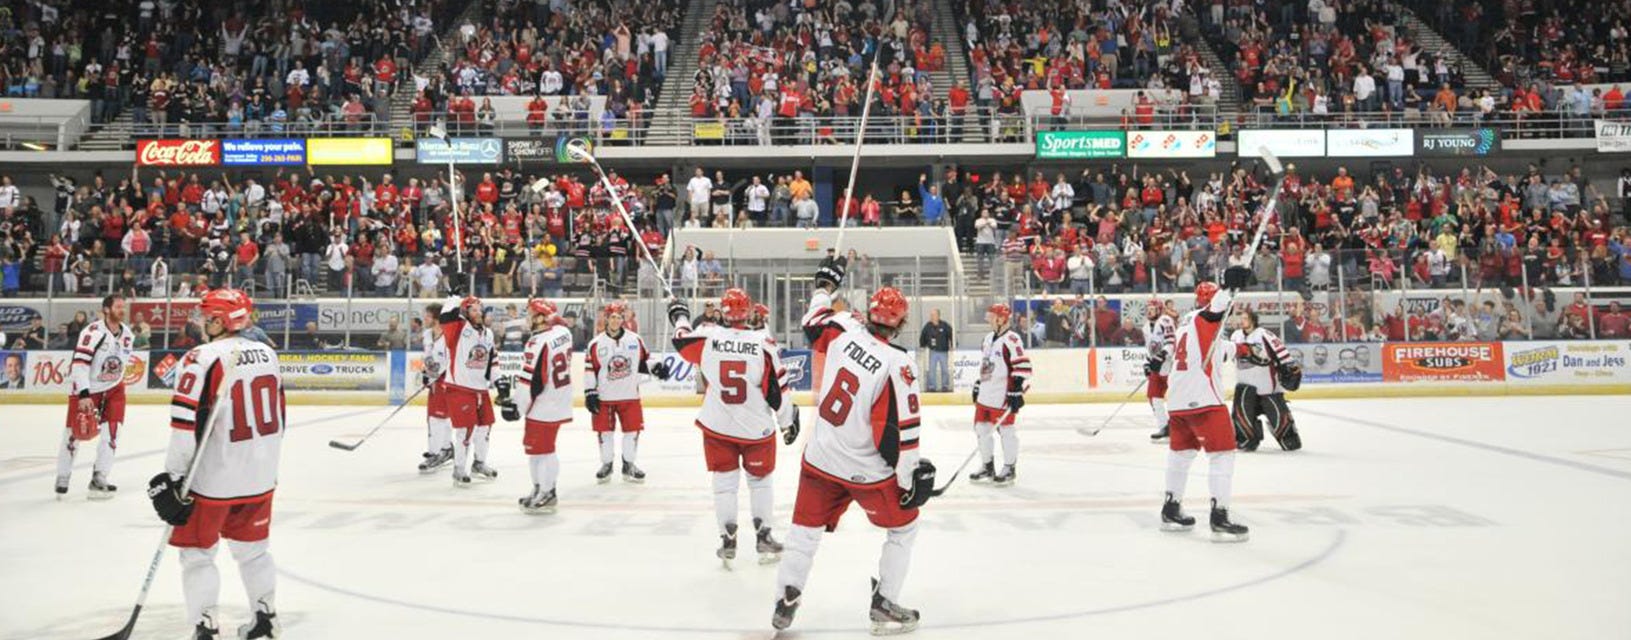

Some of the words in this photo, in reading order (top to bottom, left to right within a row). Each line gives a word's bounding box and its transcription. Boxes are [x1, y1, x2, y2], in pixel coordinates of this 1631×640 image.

[223, 142, 237, 151] We
[264, 144, 282, 153] your
[1423, 139, 1434, 149] RJ
[1438, 139, 1475, 147] YOUNG
[141, 140, 216, 165] Coca-Cola
[712, 339, 758, 356] McCLURE
[1395, 347, 1491, 363] FIREHOUSE
[842, 340, 883, 375] FIDLER
[1426, 357, 1463, 368] SUBS
[1563, 356, 1583, 367] Dan
[1586, 358, 1601, 367] and
[1603, 355, 1626, 367] Jess
[279, 365, 309, 374] DRIVE
[335, 365, 375, 374] TRUCKS
[719, 360, 748, 404] 5
[819, 366, 860, 427] 6
[229, 374, 280, 443] 10
